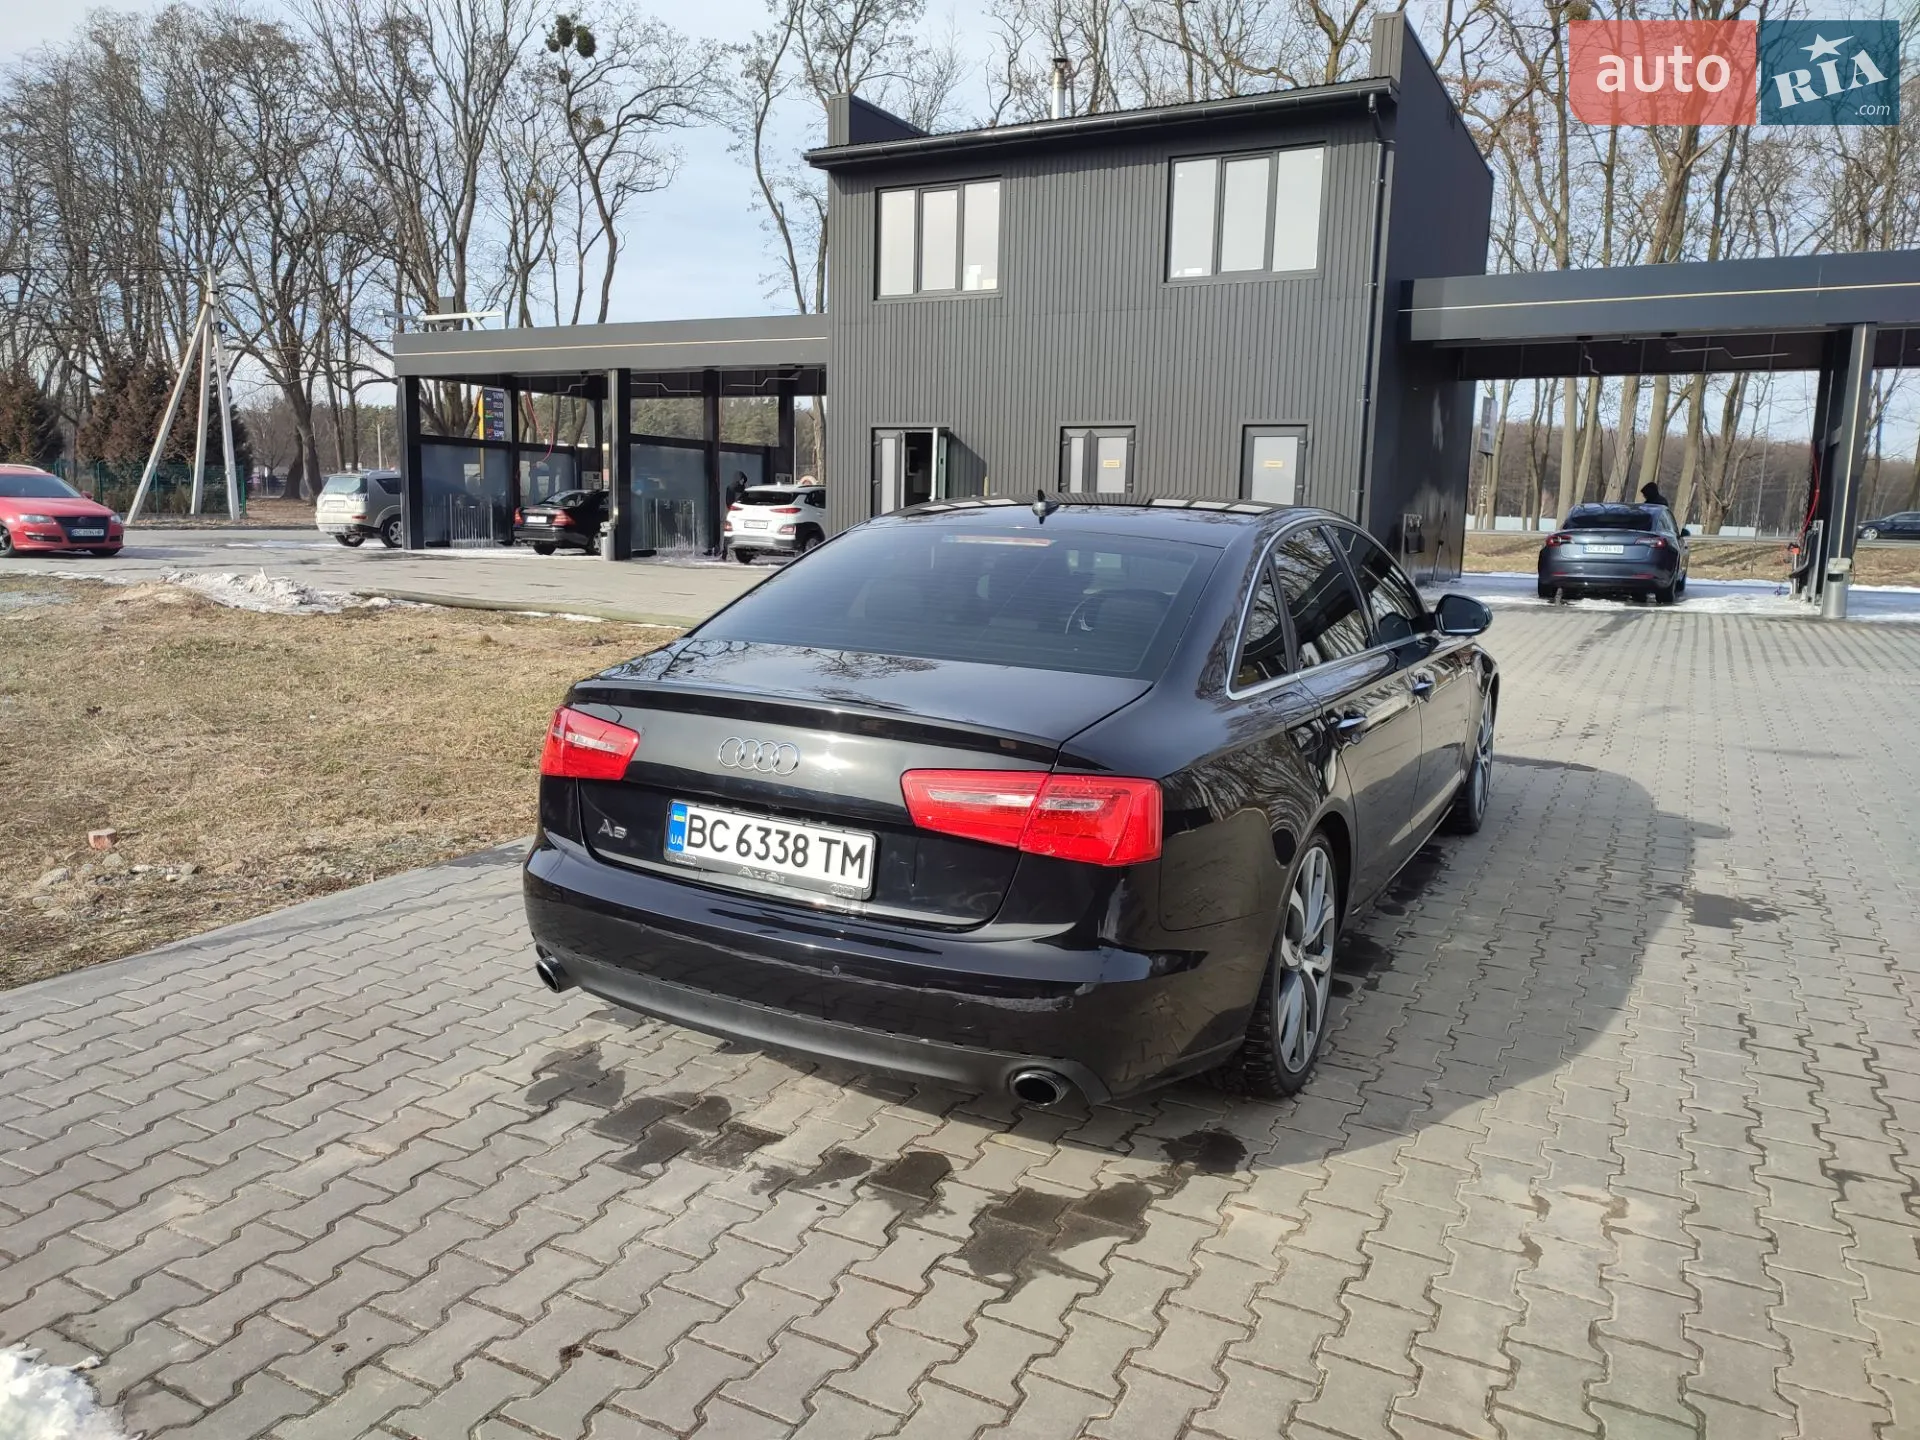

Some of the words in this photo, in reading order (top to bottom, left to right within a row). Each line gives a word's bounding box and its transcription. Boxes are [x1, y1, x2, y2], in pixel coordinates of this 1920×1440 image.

[597, 819, 628, 840] A6
[670, 833, 684, 846] UA
[686, 813, 731, 853] BC
[735, 823, 810, 868] 6338
[818, 836, 867, 880] TM
